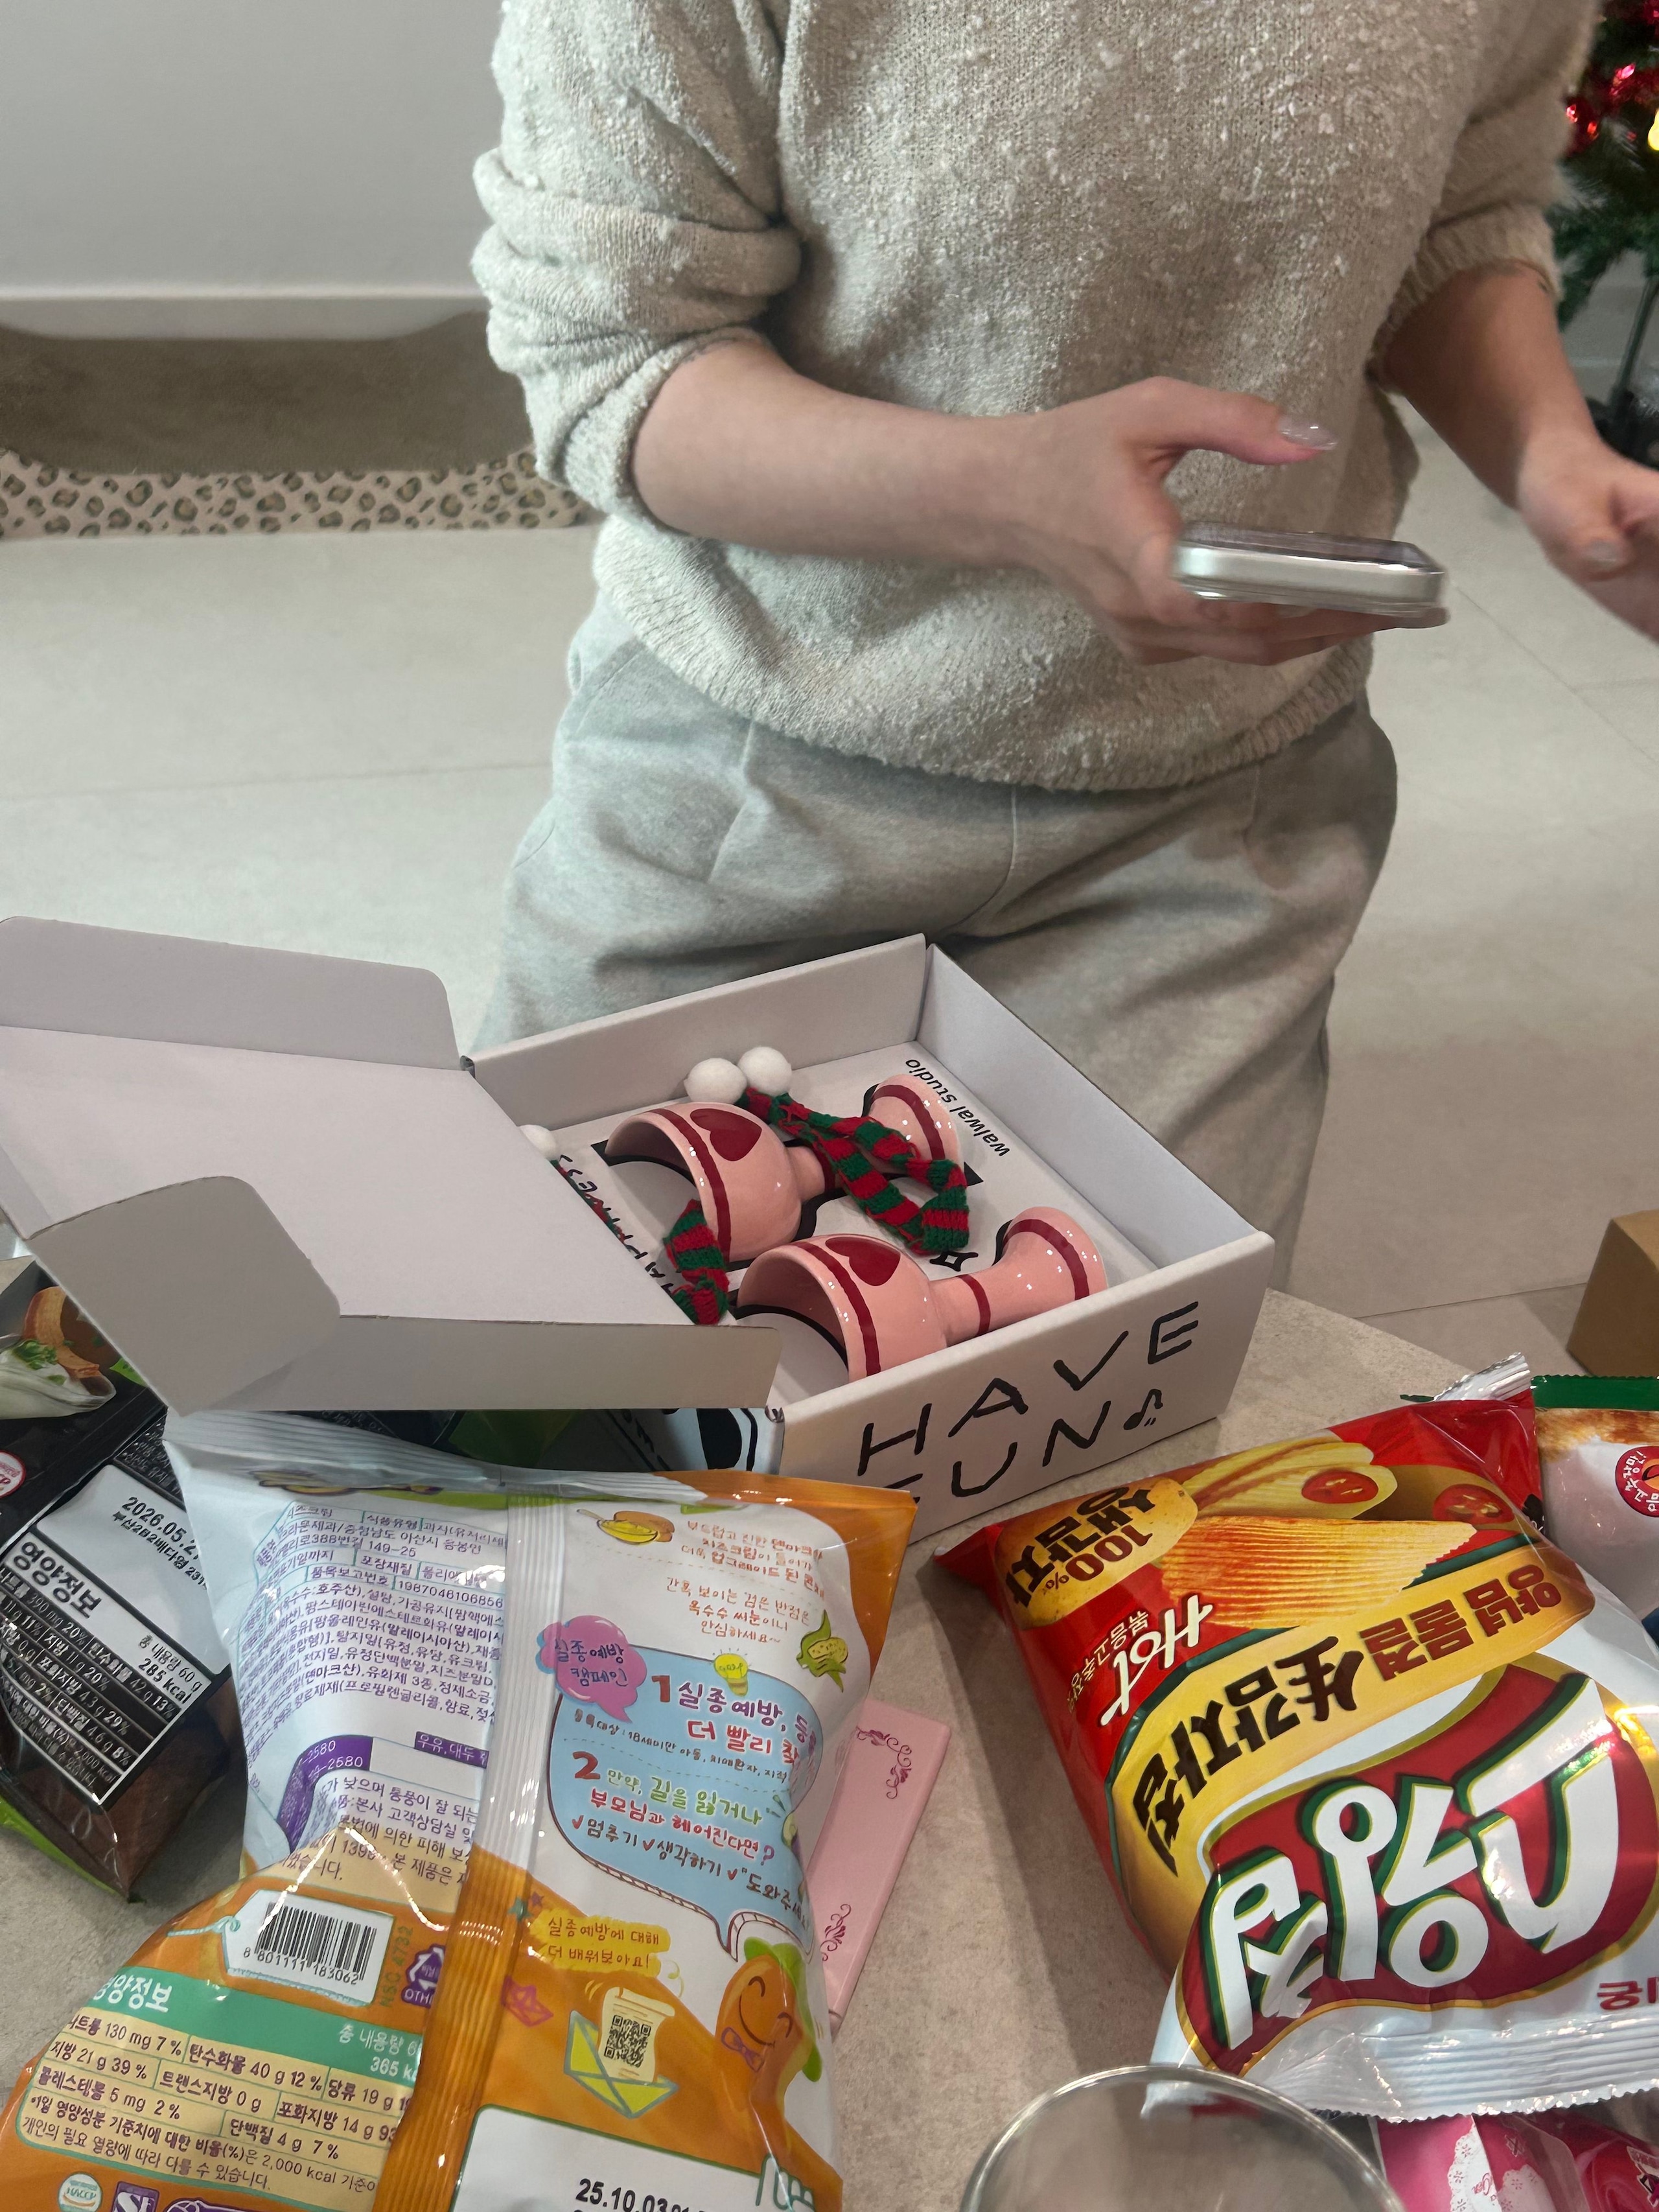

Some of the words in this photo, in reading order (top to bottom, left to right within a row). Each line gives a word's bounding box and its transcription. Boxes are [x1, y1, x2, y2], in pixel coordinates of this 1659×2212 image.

[905, 1058, 958, 1103] studio
[949, 1105, 1010, 1157] walwal
[857, 1301, 1198, 1476] HAVE
[121, 1496, 199, 1560] 2026.05.2
[1005, 1486, 1156, 1608] 생감자
[13, 1541, 102, 1619] 영양정보
[1045, 1524, 1154, 1590] 100%
[688, 1599, 728, 1620] 옥수수
[698, 1585, 738, 1605] 보이는
[744, 1591, 770, 1612] 검은
[1462, 1562, 1562, 1639] 양념
[1100, 1594, 1214, 1727] Hot
[1358, 1605, 1459, 1682] 물결
[138, 1657, 163, 1682] 285
[162, 1677, 193, 1705] kcal
[570, 1666, 629, 1687] 캠페인
[651, 1675, 671, 1703] 1
[688, 1719, 715, 1741] 더
[726, 1723, 772, 1754] 빨리
[435, 1799, 449, 1815] 잘
[572, 1751, 601, 1781] 2
[607, 1768, 644, 1795] 만약,
[649, 1776, 687, 1810] 길을
[696, 1789, 763, 1826] 잃거나
[384, 1827, 413, 1848] 의한
[417, 1837, 446, 1859] 피해
[388, 1807, 457, 1839] 고객상담실
[587, 1817, 638, 1847] 멈추기
[656, 1840, 723, 1877] 생각하기
[590, 1787, 666, 1826] 부모님과
[671, 1814, 776, 1867] 헤어진다면?
[411, 1857, 452, 1886] 제품은
[1207, 1680, 1620, 2051] 스윙칩
[548, 1944, 563, 1959] 더
[630, 1930, 660, 1946] 대해
[256, 1951, 305, 1973] 801111
[312, 1962, 360, 1986] 183062
[403, 1987, 434, 2006] OTH
[338, 2023, 355, 2044] 총
[359, 2029, 404, 2056] 내용량
[50, 2040, 77, 2062] 지방
[76, 2047, 95, 2065] 21
[97, 2056, 108, 2071] g
[110, 2056, 132, 2075] 39
[135, 2063, 148, 2080] %
[159, 2070, 233, 2106] 트랜스지방
[236, 2090, 248, 2107] 0
[251, 2097, 262, 2113] g
[276, 2101, 339, 2132] 포화지방
[342, 2115, 360, 2134] 14
[363, 2125, 375, 2141] g
[105, 2021, 128, 2040] 130
[129, 2032, 152, 2051] mg
[156, 2035, 167, 2051] 7
[170, 2040, 183, 2057] %
[189, 2043, 247, 2075] 탄수화물
[249, 2061, 271, 2078] 40
[274, 2070, 286, 2086] g
[291, 2071, 307, 2089] 12
[310, 2075, 323, 2092] %
[329, 2078, 357, 2102] 당류
[362, 2088, 379, 2105] 19
[383, 2096, 394, 2112] g
[369, 2056, 400, 2078] 365
[38, 2066, 106, 2102] 콜레스테롤
[109, 2086, 121, 2103] 5
[122, 2093, 146, 2113] mg
[153, 2099, 166, 2117] 2
[168, 2103, 181, 2121] %
[229, 2117, 275, 2146] 단백질
[277, 2132, 288, 2147] 4
[292, 2137, 303, 2152] g
[312, 2139, 324, 2155] 7
[327, 2143, 339, 2160] %
[22, 2116, 61, 2142] 개인의
[63, 2126, 89, 2147] 필요
[92, 2135, 133, 2162] 열량에
[134, 2147, 161, 2169] 따라
[165, 2156, 192, 2176] 다를
[196, 2161, 211, 2180] 수
[215, 2162, 271, 2192] 있습니다.
[56, 2100, 106, 2130] 영양성분
[108, 2116, 163, 2145] 기준치에
[164, 2131, 191, 2152] 대한
[195, 2138, 259, 2166] 비율(%)은
[261, 2154, 303, 2175] 2,000
[306, 2165, 337, 2184] kcal
